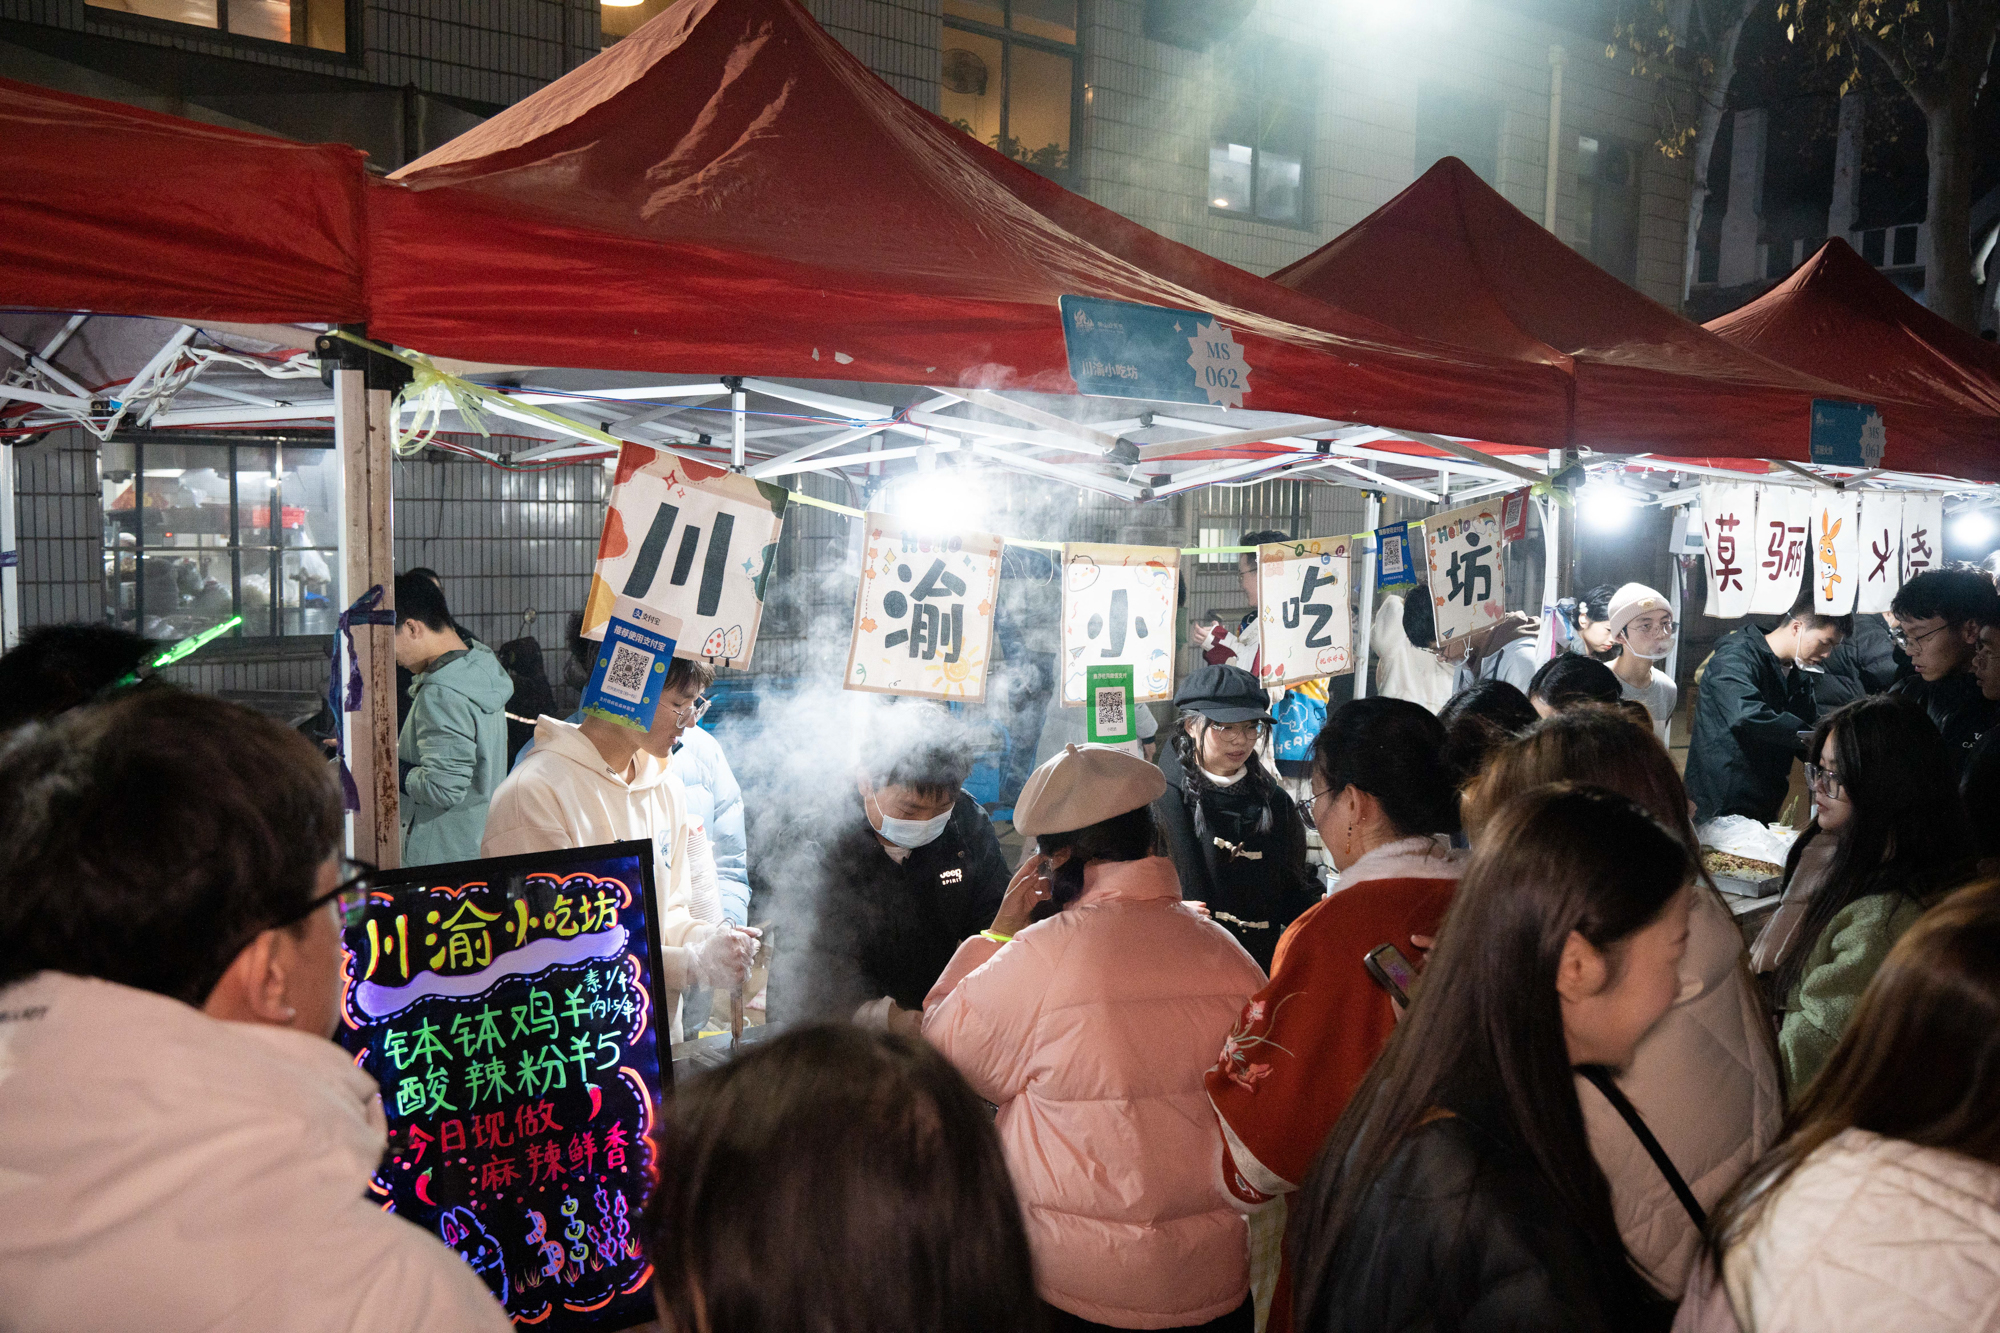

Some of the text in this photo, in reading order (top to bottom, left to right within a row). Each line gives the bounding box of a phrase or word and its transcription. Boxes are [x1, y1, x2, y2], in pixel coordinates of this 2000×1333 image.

[1205, 341, 1231, 360] MS
[1082, 360, 1138, 380] 川渝小吃坊
[1205, 366, 1240, 389] 062
[1438, 519, 1471, 543] Hello
[622, 502, 735, 616] 川
[614, 625, 666, 652] 推荐使用支付宝
[409, 1098, 564, 1165] 今日现做
[481, 1121, 629, 1191] 麻辣鲜香
